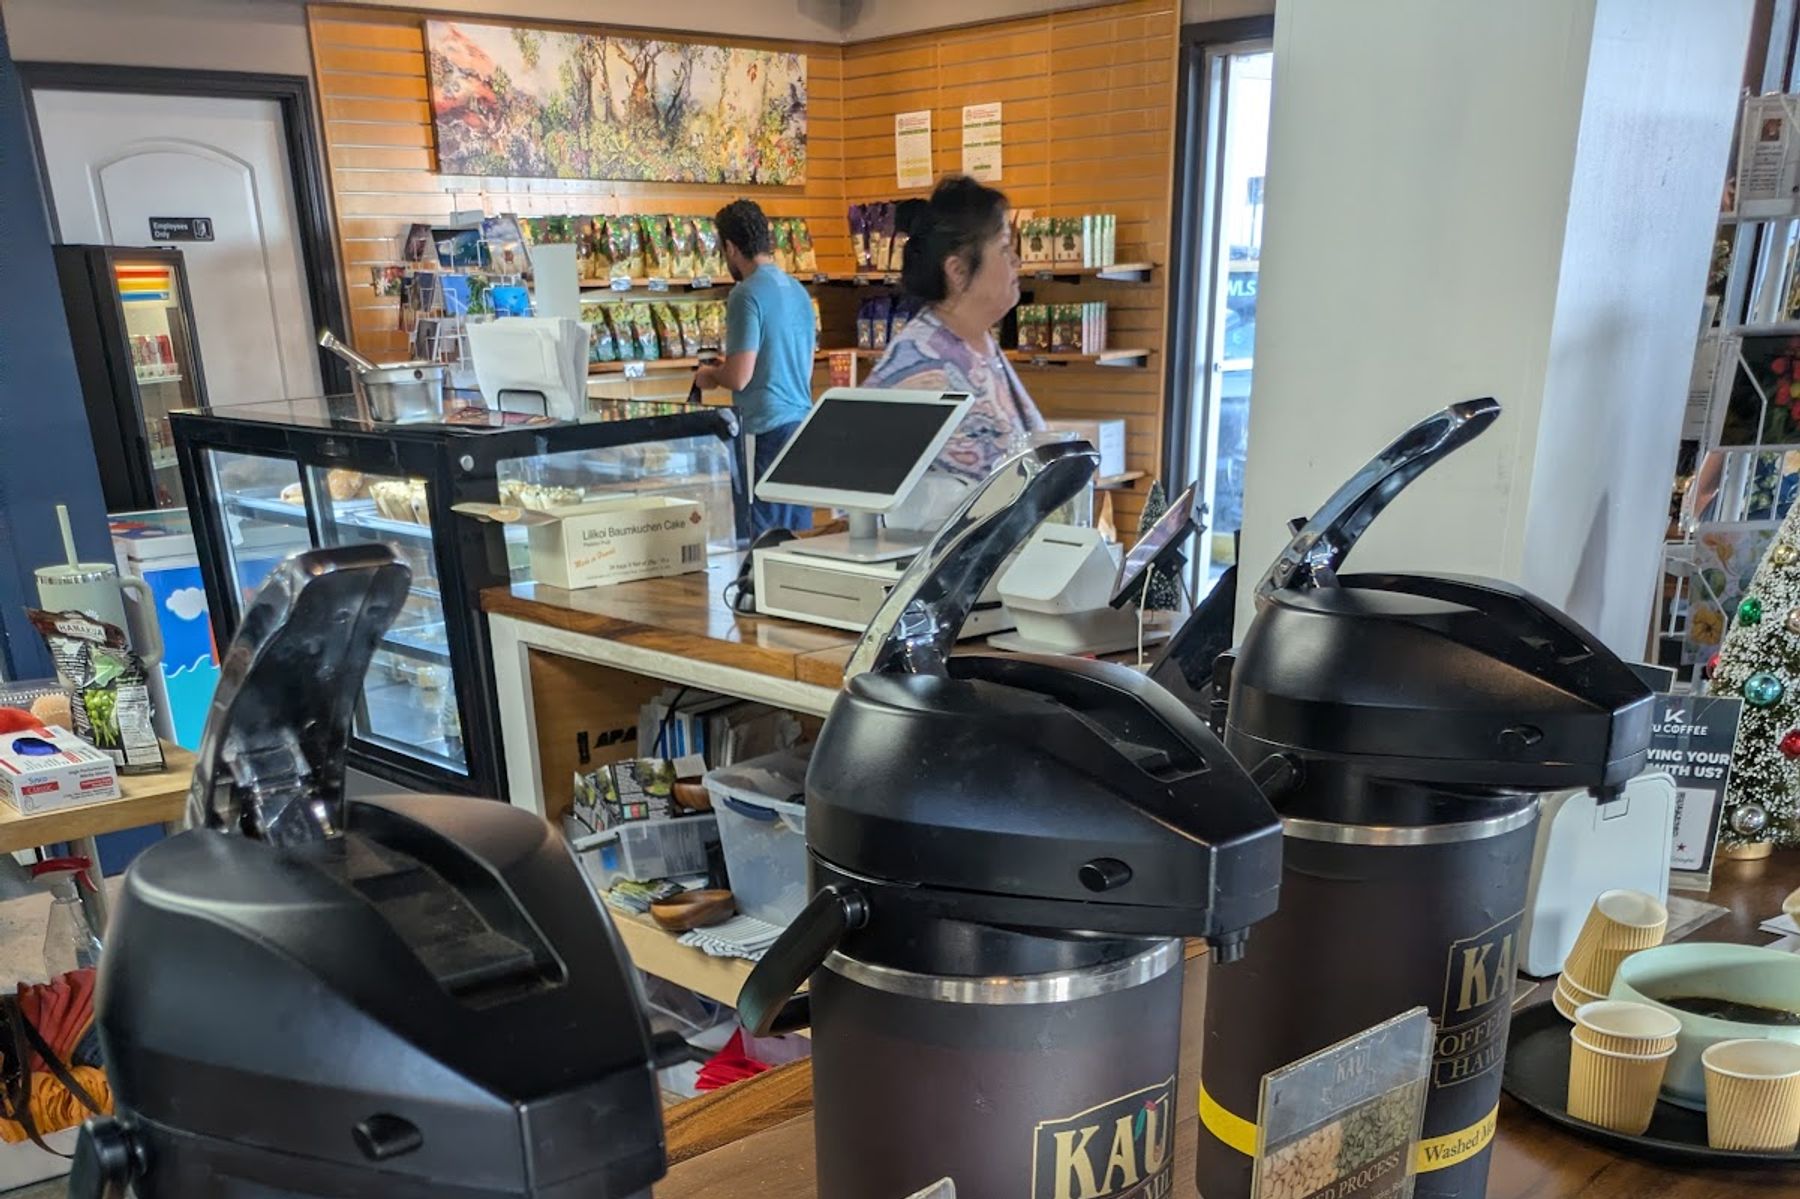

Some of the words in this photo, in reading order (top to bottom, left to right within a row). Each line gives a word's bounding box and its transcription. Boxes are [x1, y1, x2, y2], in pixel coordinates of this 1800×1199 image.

[153, 222, 189, 231] Employees
[154, 231, 170, 240] Only
[608, 521, 663, 538] Baumkuchen
[664, 520, 686, 530] Cake
[1663, 723, 1708, 736] COFFEE
[1687, 750, 1731, 766] YOUR
[1694, 766, 1724, 779] US?
[1424, 1130, 1480, 1163] Washed
[1338, 1152, 1400, 1199] PROCESS
